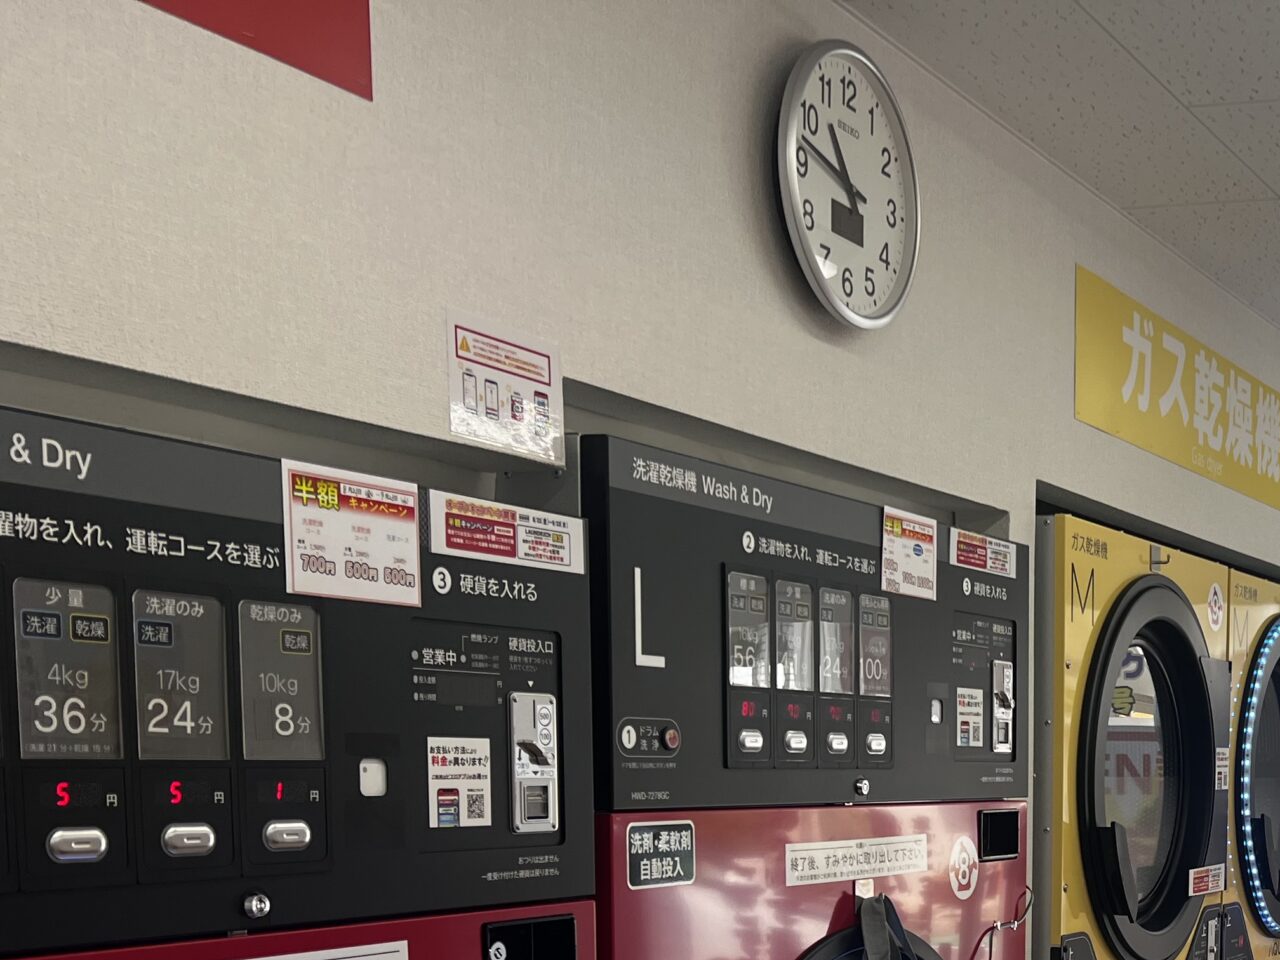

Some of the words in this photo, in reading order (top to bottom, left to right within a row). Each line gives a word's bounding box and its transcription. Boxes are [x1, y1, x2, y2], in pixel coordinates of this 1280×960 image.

[819, 74, 831, 108] 11
[840, 76, 857, 113] 12
[801, 99, 819, 136] 10
[837, 119, 860, 139] SEIKO
[868, 106, 875, 136] 1
[796, 146, 808, 178] 9
[881, 147, 892, 178] 2
[803, 199, 815, 231] 8
[886, 199, 897, 229] 3
[819, 243, 831, 266] 7
[879, 242, 890, 271] 4
[842, 267, 854, 298] 6
[864, 266, 875, 298] 5
[1121, 311, 1280, 483] ガス乾燥機
[10, 433, 31, 464] &
[41, 438, 92, 480] Dry
[294, 477, 340, 512] 半額
[633, 457, 697, 493] 洗濯乾燥機
[702, 475, 737, 502] Wash
[740, 485, 749, 505] &
[752, 488, 773, 514] Dry
[349, 498, 408, 518] キャンペーン
[1071, 532, 1108, 560] ガス乾燥機
[45, 586, 84, 608] 少量
[460, 573, 537, 601] 硬貨を入れる
[1070, 562, 1095, 627] M
[145, 596, 204, 617] 洗濯のみ
[250, 604, 302, 624] 乾燥のみ
[634, 566, 666, 669] L
[26, 616, 58, 634] 洗濯
[75, 620, 105, 638] 乾燥
[141, 625, 169, 642] 洗濯
[1233, 607, 1249, 656] M
[284, 633, 308, 650] 乾燥
[508, 636, 554, 653] 硬貨投入口
[422, 647, 457, 666] 営業中
[48, 664, 88, 689] 4kg
[157, 670, 200, 694] 17kg
[258, 672, 298, 695] 10kg
[34, 695, 107, 734] 36分
[147, 698, 213, 734] 24分
[275, 703, 311, 736] 8分
[639, 726, 660, 737] ドラム
[106, 794, 118, 807] 円
[214, 791, 225, 804] 円
[310, 789, 320, 802] 円
[630, 830, 691, 854] 洗剤・柔軟剤
[640, 857, 684, 881] 自動投入
[957, 852, 970, 886] 8
